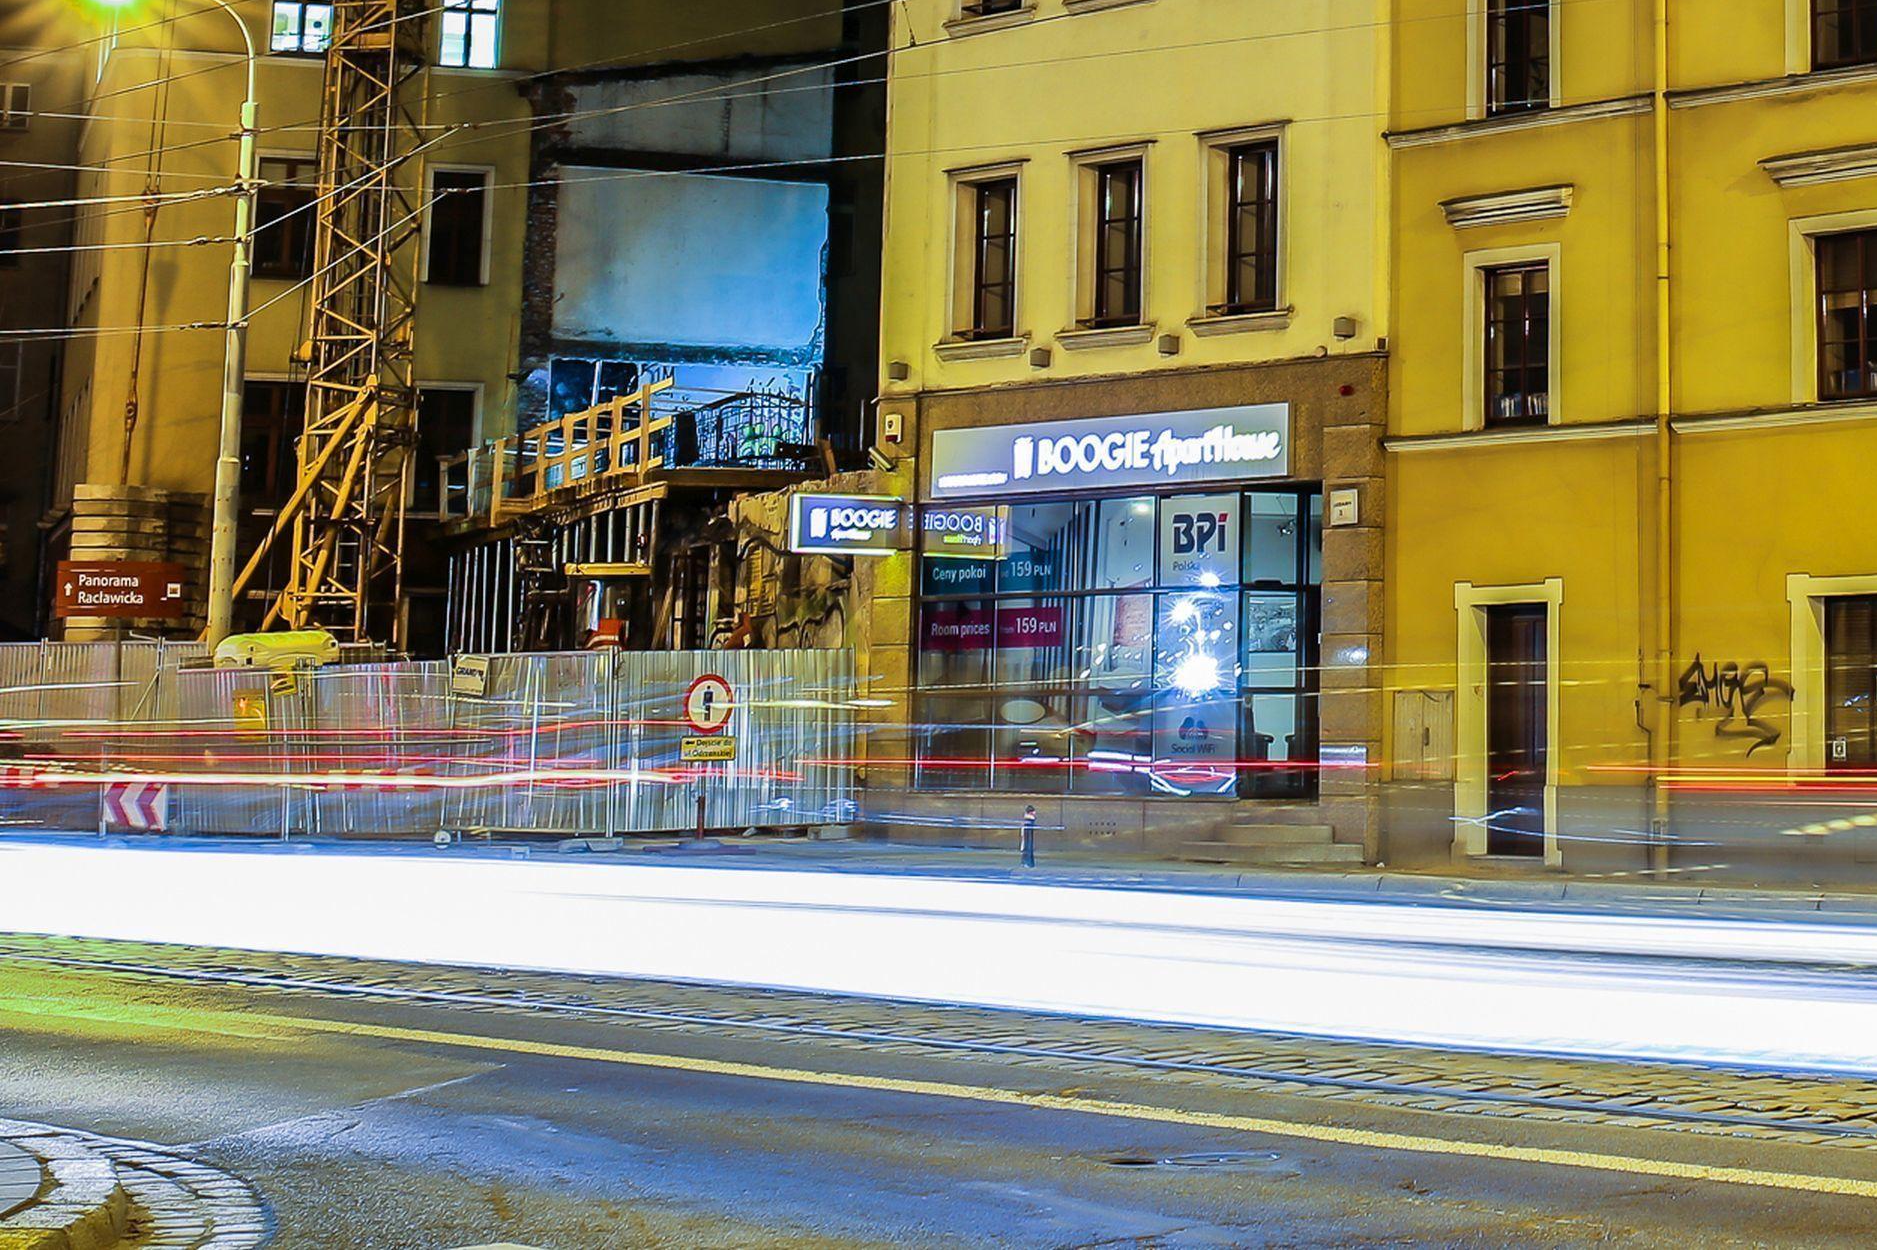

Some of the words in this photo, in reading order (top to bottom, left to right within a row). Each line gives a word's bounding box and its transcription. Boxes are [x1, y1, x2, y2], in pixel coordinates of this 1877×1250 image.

[1037, 430, 1150, 475] BOOGIE
[830, 507, 897, 529] BOOGIE
[78, 574, 139, 587] Panorama
[932, 567, 957, 584] Ceny
[958, 564, 986, 584] pokoi
[1011, 561, 1032, 577] 159
[1034, 564, 1051, 576] PLN
[78, 591, 144, 604] Racławicka
[931, 622, 959, 637] Room
[960, 621, 990, 639] prices
[1016, 617, 1037, 634] 159
[1039, 621, 1057, 633] PLN
[1171, 743, 1195, 754] Social
[1197, 743, 1216, 754] WiFi
